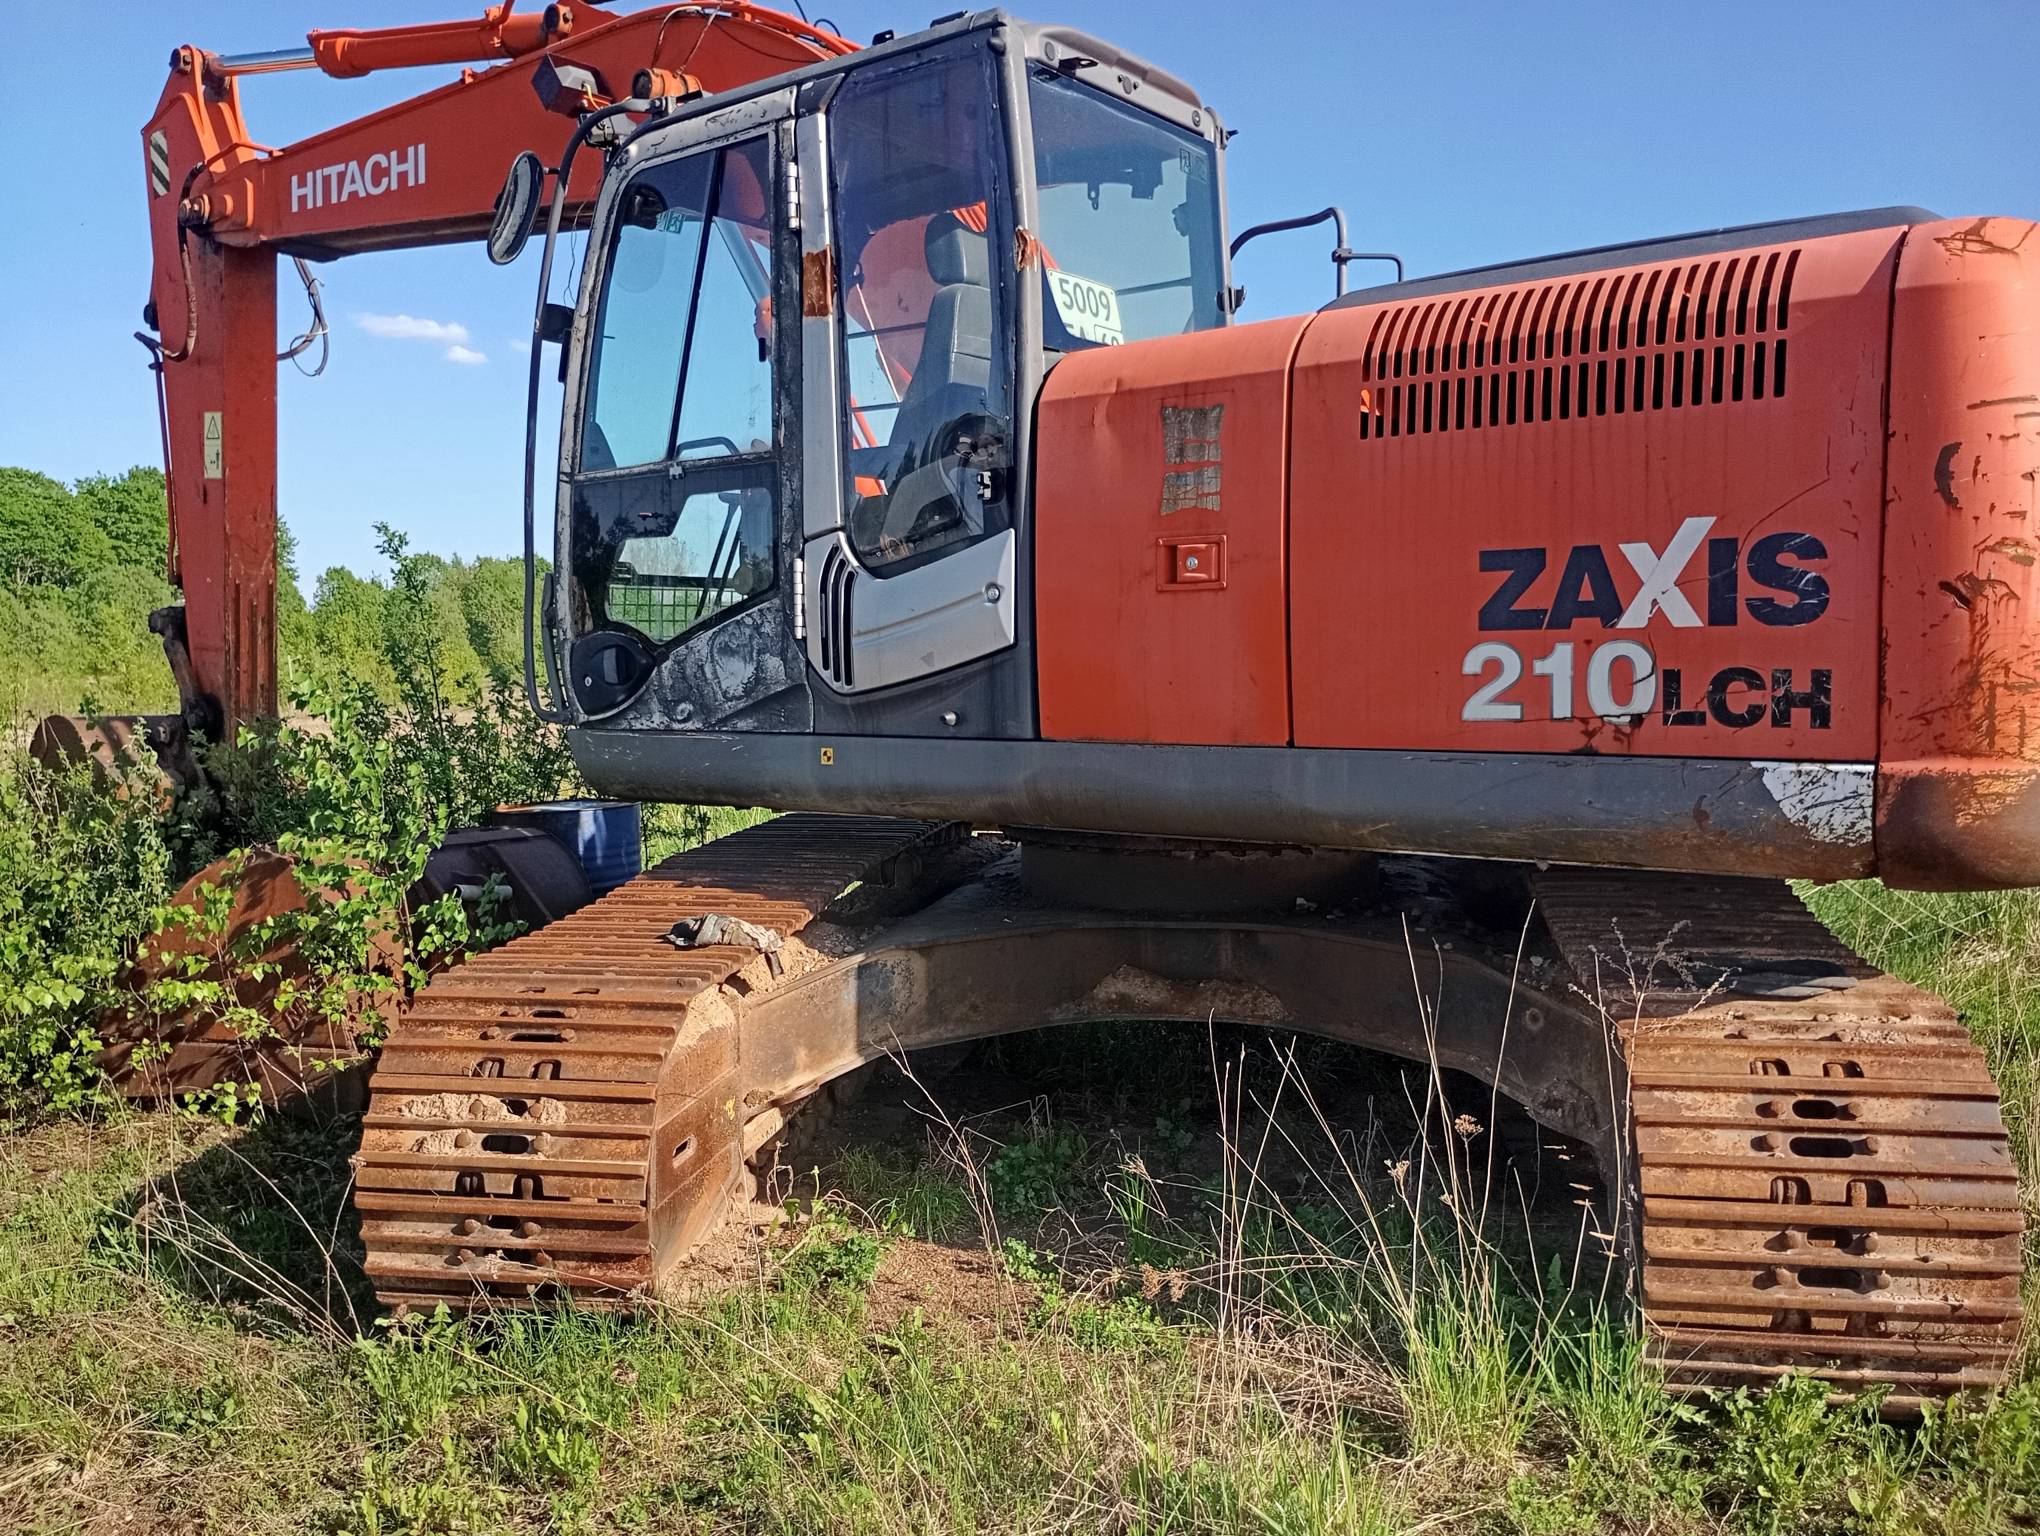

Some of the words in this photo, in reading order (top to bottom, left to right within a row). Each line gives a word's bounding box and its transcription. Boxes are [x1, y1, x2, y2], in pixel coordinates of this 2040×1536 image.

[291, 143, 426, 213] HITACHI
[1058, 277, 1111, 322] 5009
[1478, 516, 1830, 631] ZAXIS
